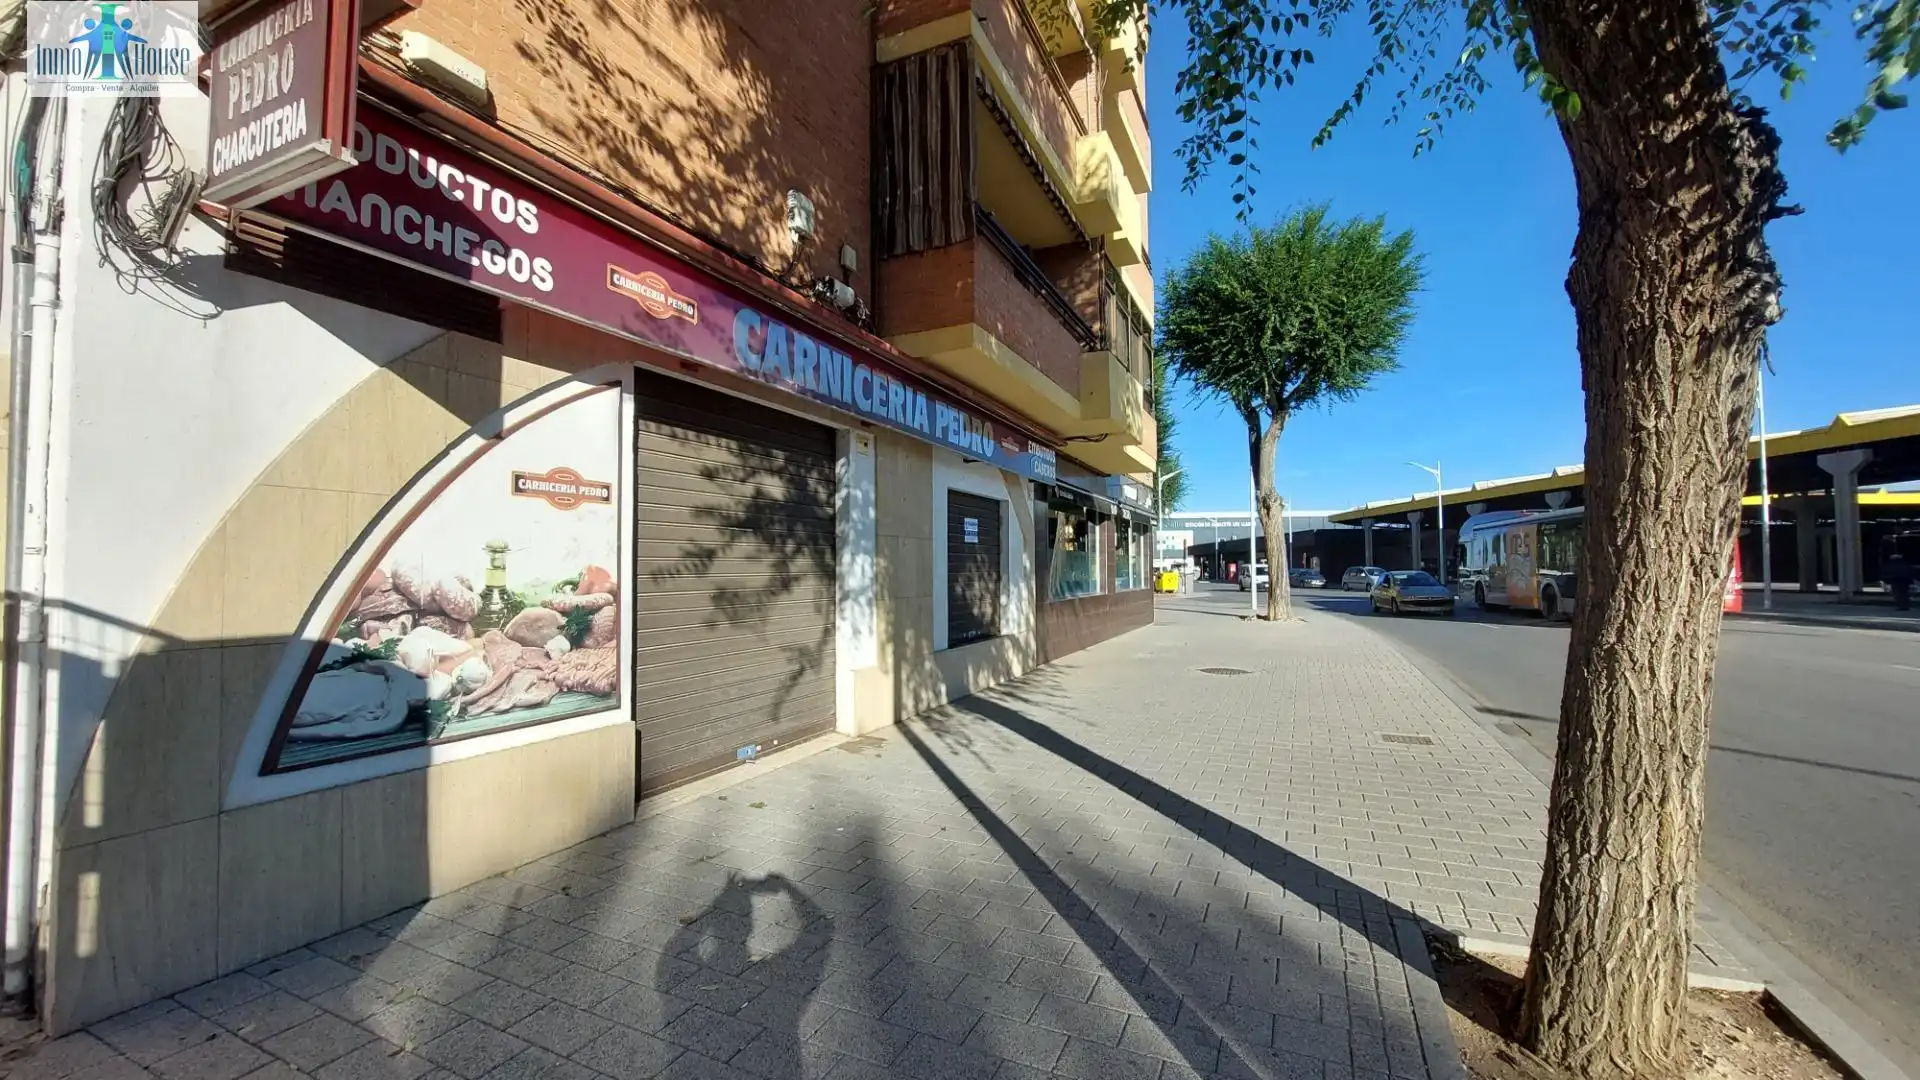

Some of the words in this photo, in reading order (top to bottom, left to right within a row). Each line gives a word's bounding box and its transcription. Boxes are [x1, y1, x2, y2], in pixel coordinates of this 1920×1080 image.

[219, 0, 313, 72] CARNICERIA
[227, 41, 295, 119] PEDRO
[212, 98, 307, 177] CHARCUTERIA
[354, 121, 539, 234] ODUCTOS
[612, 273, 666, 303] CARNICERIA
[667, 296, 694, 315] PEDRO
[733, 308, 929, 434] CARNICERIA
[935, 400, 994, 457] PEDRO
[518, 479, 576, 494] CARNICERIA
[579, 485, 608, 498] PEDRO
